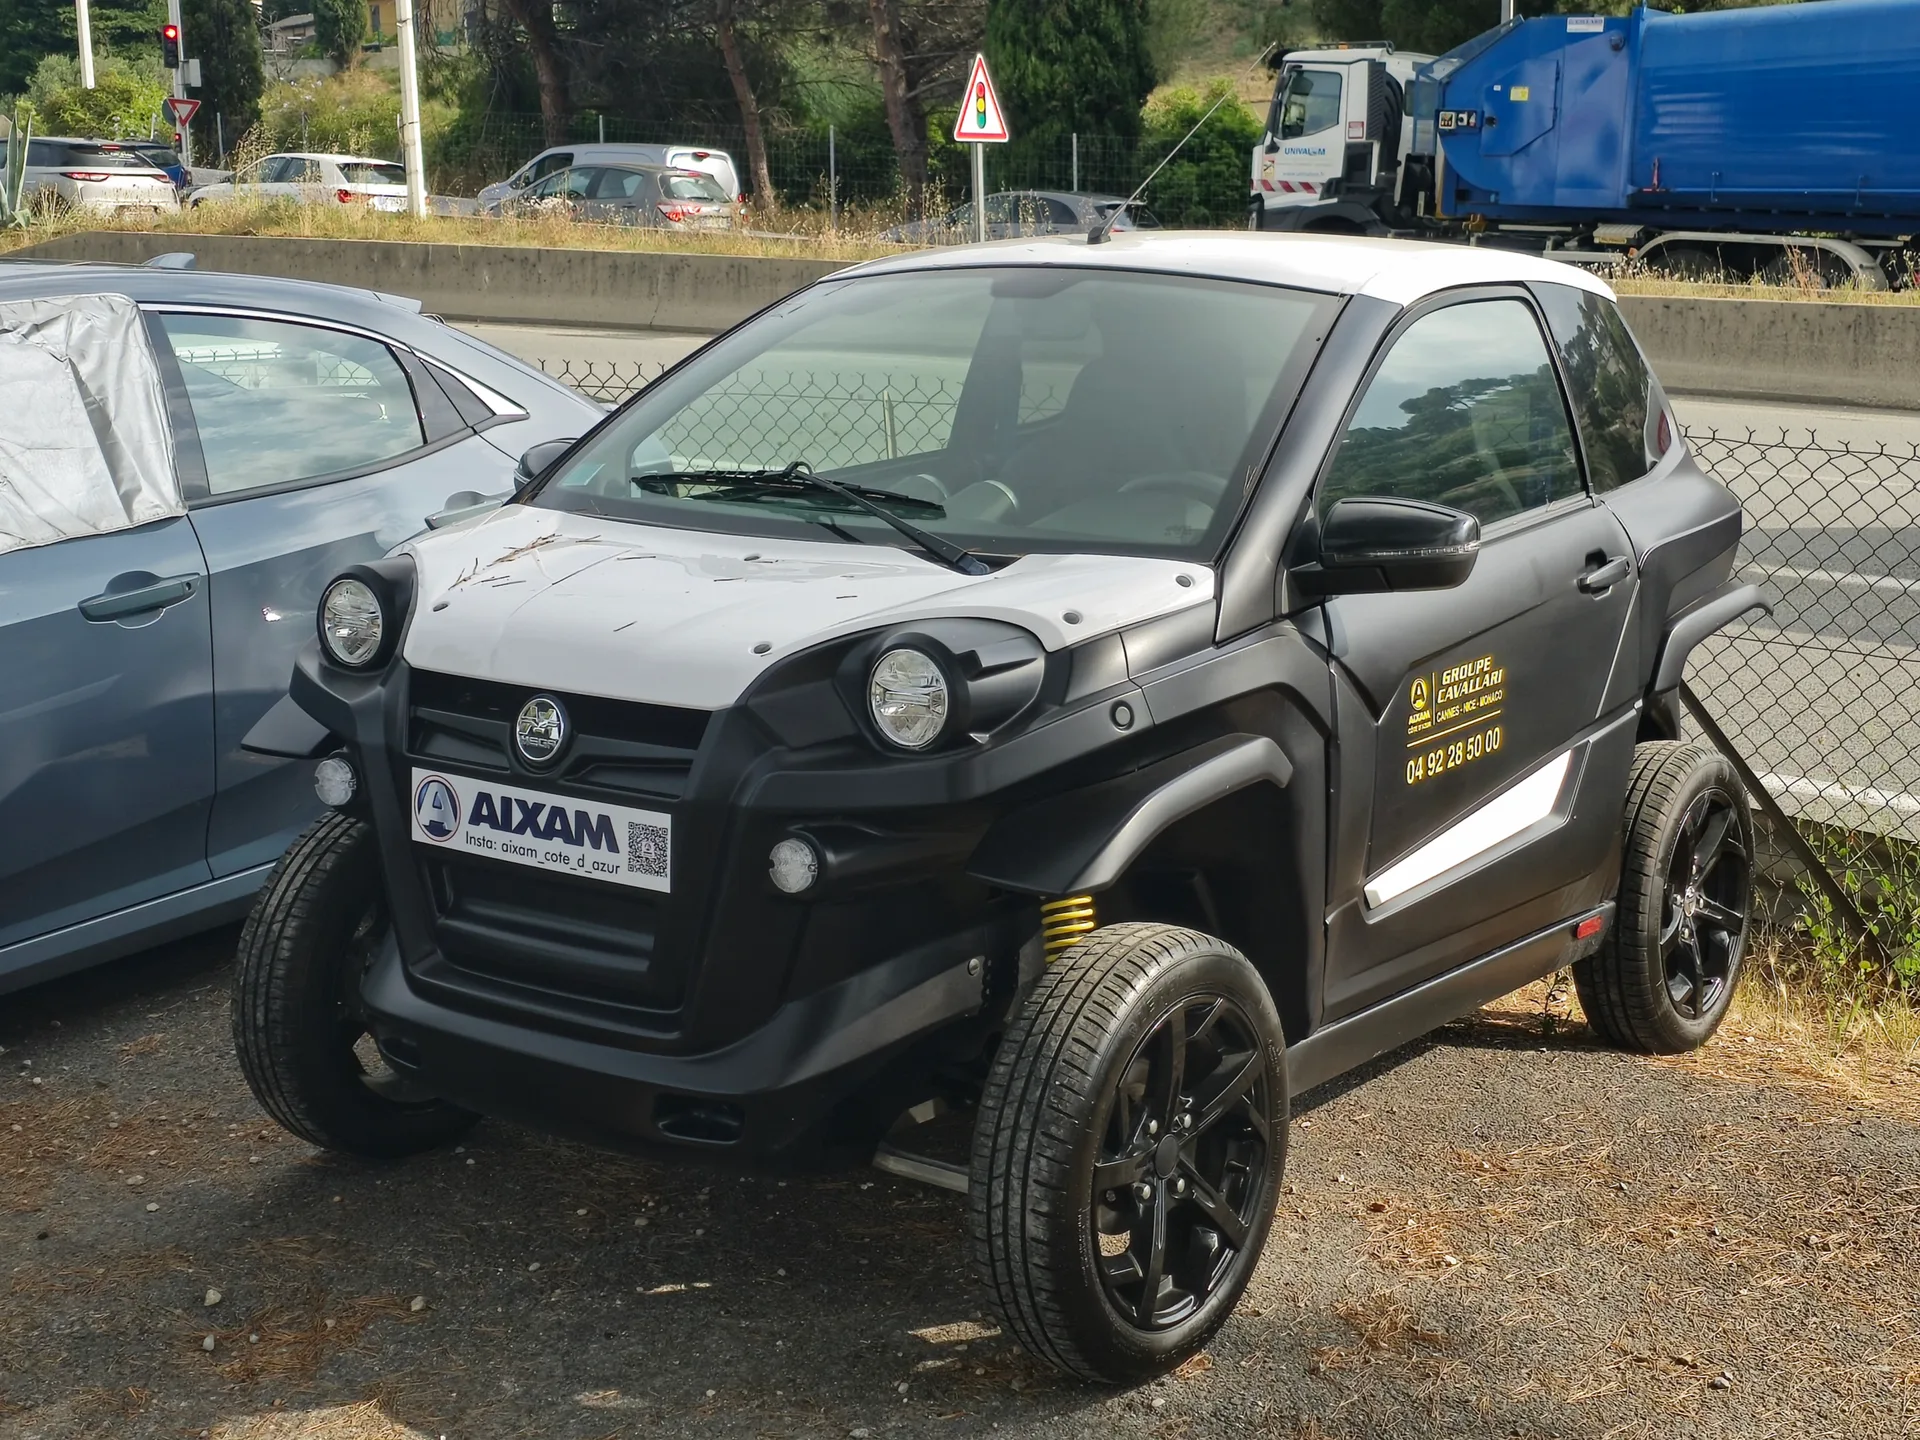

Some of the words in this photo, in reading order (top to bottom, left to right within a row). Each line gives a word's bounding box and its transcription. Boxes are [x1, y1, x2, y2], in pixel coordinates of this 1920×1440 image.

[1437, 669, 1503, 703] CAVALLARI
[1442, 657, 1491, 685] GROUPE
[1408, 710, 1431, 725] AIXAM
[1437, 705, 1459, 722] CANNES
[1463, 698, 1476, 713] NICE
[1480, 690, 1502, 707] MONACO
[520, 735, 557, 749] MEGA
[1407, 757, 1423, 784] 04
[1428, 749, 1444, 776] 92
[1447, 741, 1463, 769] 28
[1466, 734, 1481, 760] 50
[1485, 727, 1500, 753] 00
[468, 791, 620, 854] AIXAM
[465, 831, 497, 850] Insta:
[501, 839, 620, 875] aixam_cote_d_azur
